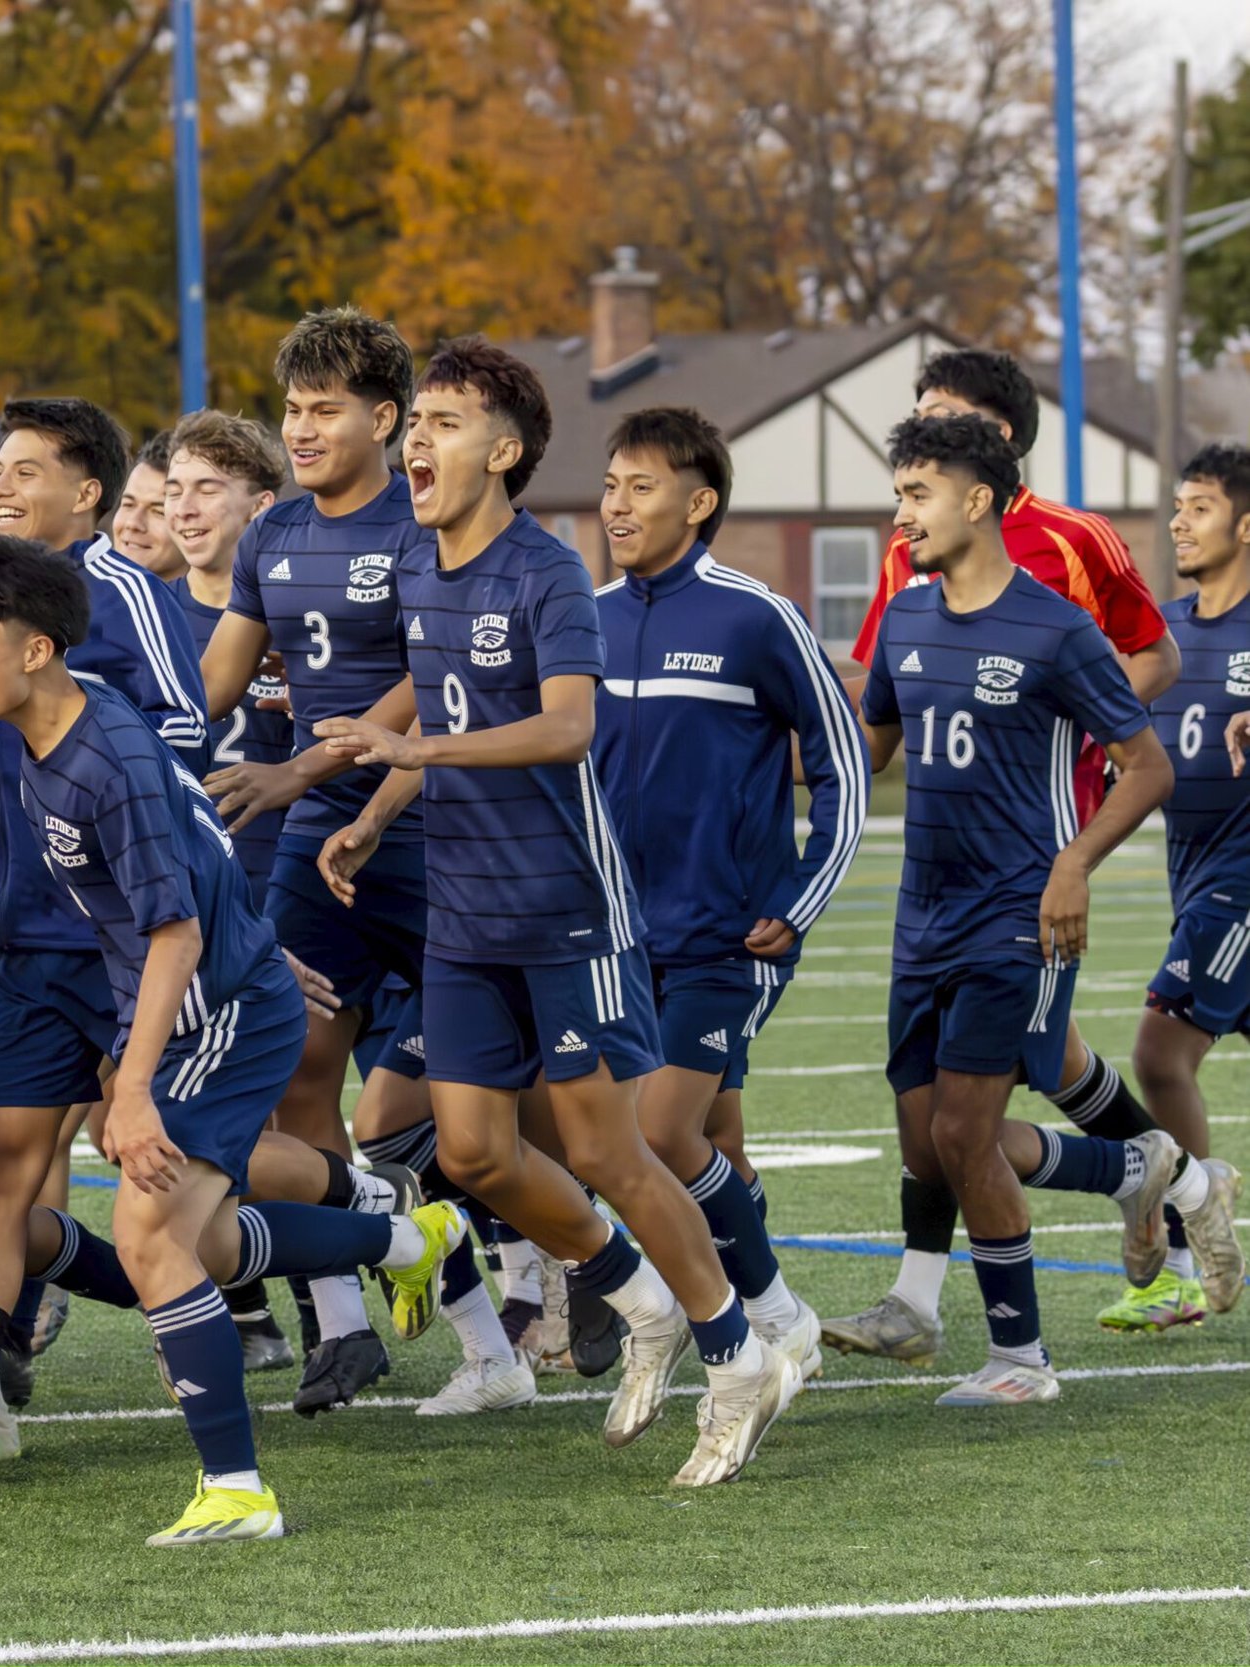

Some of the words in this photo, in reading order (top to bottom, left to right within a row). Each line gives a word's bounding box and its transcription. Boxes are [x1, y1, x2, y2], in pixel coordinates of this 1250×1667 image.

[349, 554, 392, 572] LEYDEN
[346, 585, 390, 603] SOCCER
[472, 614, 509, 633] LEYDEN
[304, 611, 331, 670] 3
[471, 649, 512, 667] SOCCER
[663, 652, 724, 674] LEYDEN
[977, 656, 1025, 677] LEYDEN
[247, 681, 286, 699] OCCER
[974, 685, 1019, 705] SOCCER
[443, 672, 469, 735] 9
[921, 705, 975, 769] 16
[1179, 703, 1206, 759] 6
[45, 815, 81, 842] LEYDEN
[555, 1042, 588, 1053] adidas
[700, 1036, 728, 1054] adidas
